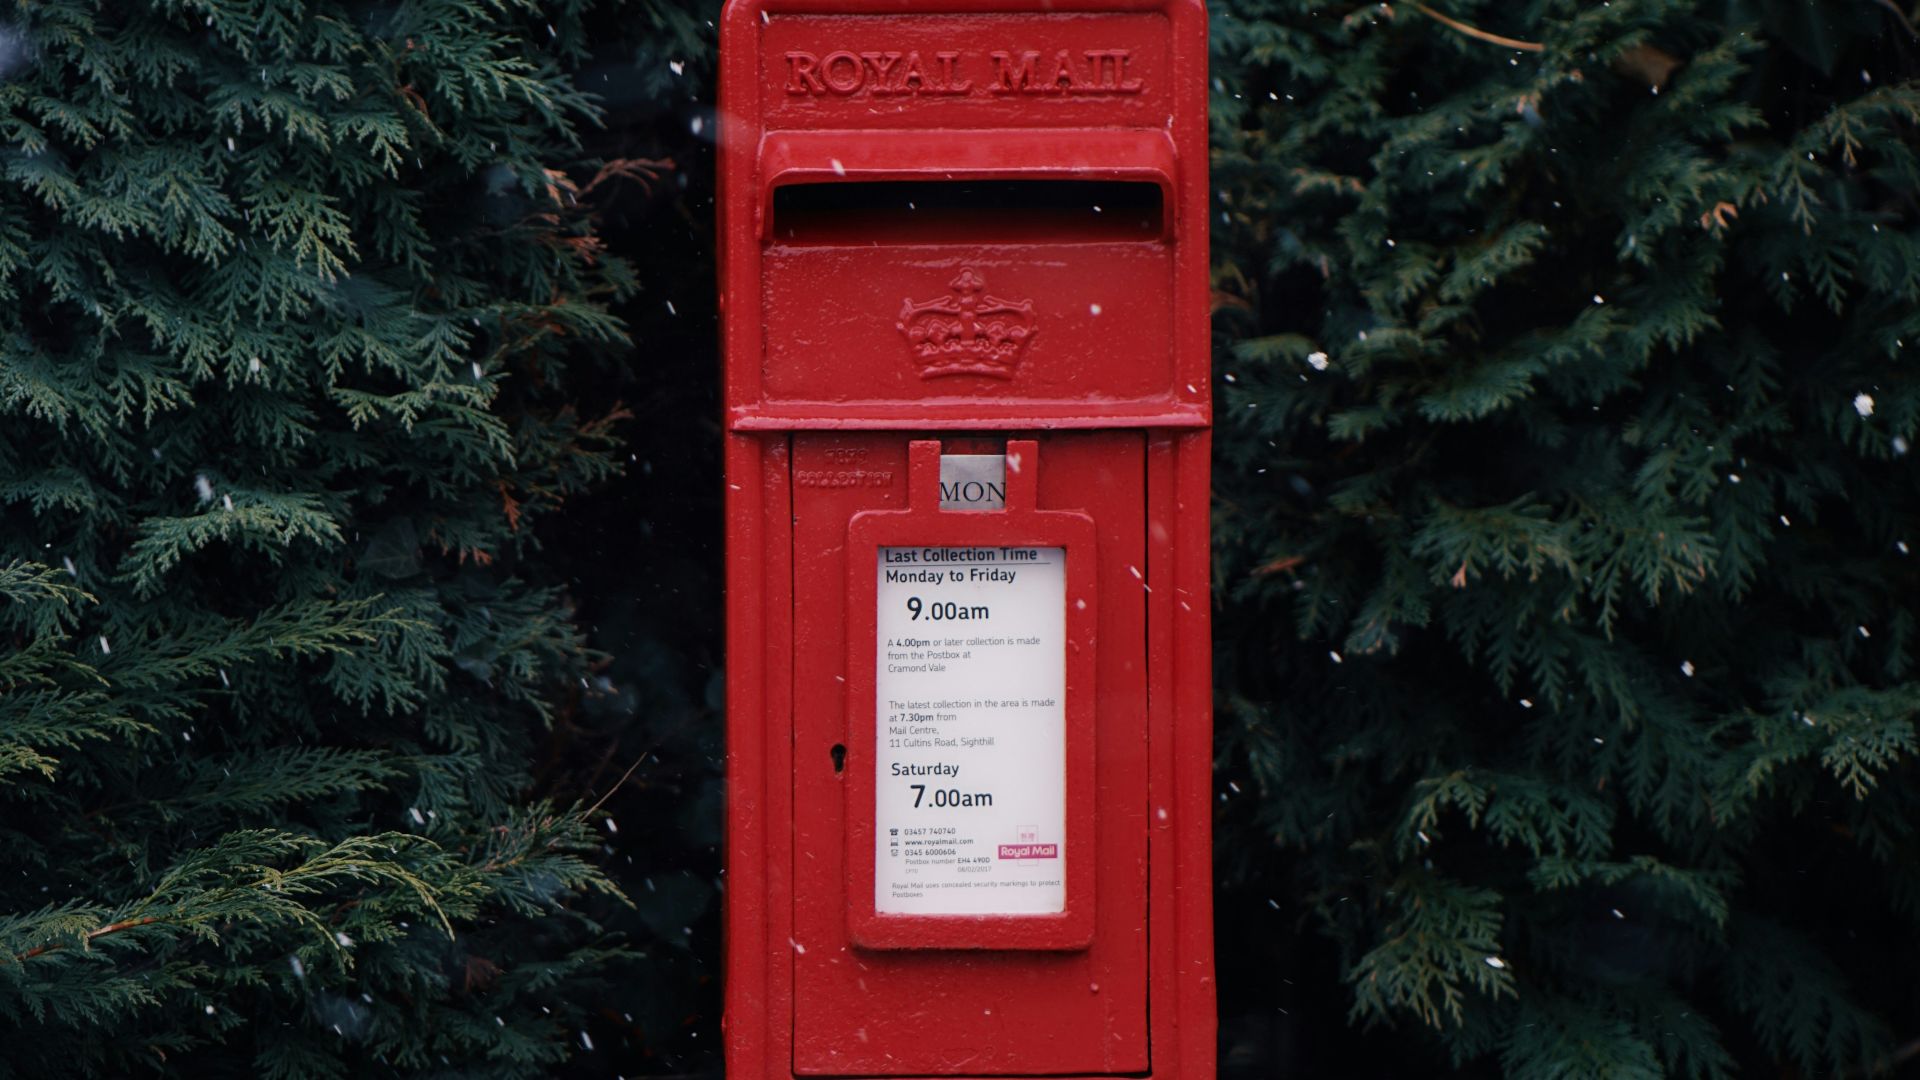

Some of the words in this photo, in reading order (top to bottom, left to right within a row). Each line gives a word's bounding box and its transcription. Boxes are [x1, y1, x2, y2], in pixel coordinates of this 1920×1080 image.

[785, 51, 972, 95] ROYAL
[991, 49, 1143, 94] MAIL
[940, 481, 1006, 502] MON
[885, 549, 918, 563] Last
[922, 548, 995, 562] Collection
[1000, 548, 1038, 560] Time
[886, 569, 944, 585] Monday
[949, 569, 964, 582] to
[970, 568, 1016, 584] Friday
[907, 596, 990, 621] 9.00am
[887, 638, 894, 647] A
[896, 638, 931, 649] 4.00pm
[944, 638, 963, 647] later
[966, 636, 1005, 646] collection
[1007, 637, 1014, 645] is
[1016, 637, 1041, 645] made
[888, 651, 909, 660] from
[911, 650, 925, 660] the
[927, 650, 960, 660] Postbox
[962, 650, 971, 659] at
[888, 663, 927, 673] Cramond
[928, 663, 947, 672] Vale
[889, 700, 905, 710] The
[907, 699, 931, 709] latest
[933, 698, 972, 709] collection
[974, 698, 983, 708] in
[984, 699, 999, 708] the
[1000, 700, 1020, 708] area
[1021, 699, 1029, 707] is
[1031, 698, 1056, 707] made
[889, 713, 898, 722] at
[900, 712, 934, 723] 7.30pm
[936, 712, 957, 721] from
[889, 725, 907, 735] Mail
[909, 724, 940, 735] Centre,
[889, 738, 900, 748] 11
[903, 737, 932, 748] Cultins
[934, 736, 959, 748] Road,
[961, 736, 995, 748] Sighthill
[891, 762, 960, 778] Saturday
[910, 784, 993, 808] 7.00am
[929, 827, 956, 835] 740740
[905, 838, 974, 846] www.royalmail.com
[1001, 846, 1030, 857] Royal
[1032, 845, 1055, 856] Mail
[999, 880, 1029, 888] markings
[1038, 879, 1061, 888] protect
